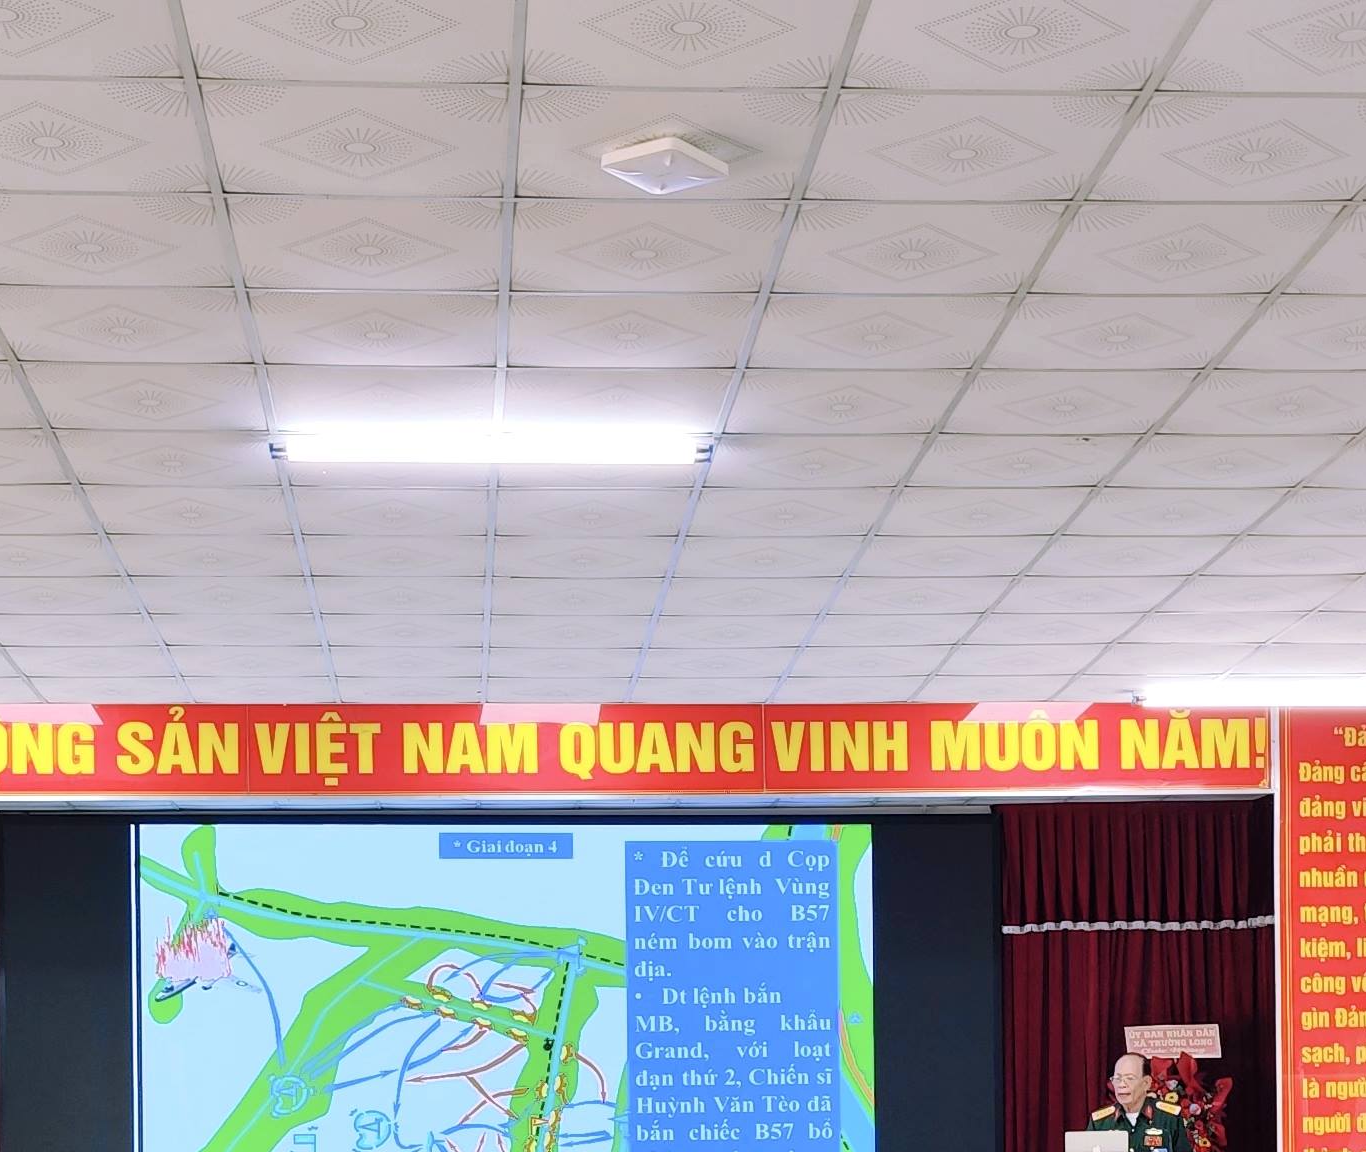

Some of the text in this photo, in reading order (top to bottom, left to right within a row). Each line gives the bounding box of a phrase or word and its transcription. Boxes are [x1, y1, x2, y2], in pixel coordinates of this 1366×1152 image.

[116, 707, 239, 775] SẢN
[254, 711, 381, 786] VIỆT
[404, 720, 537, 774] NAM
[559, 720, 754, 780] QUANG
[771, 720, 909, 771] VINH
[930, 709, 1099, 772] MUÔN
[1299, 760, 1345, 784] Đảng
[1300, 795, 1346, 819] đảng
[467, 840, 502, 853] Giai
[548, 841, 558, 853] 4
[1299, 829, 1342, 855] phải
[705, 850, 742, 868] cứu
[787, 851, 830, 872] Cọp
[682, 879, 713, 896] Tư
[719, 878, 762, 899] lệnh
[775, 878, 830, 899] Vùng
[634, 905, 830, 923] IV/CT cho B57
[634, 932, 830, 952] ném bom vào trận
[693, 987, 736, 1008] lệnh
[744, 983, 782, 1004] bắn
[636, 1009, 831, 1035] MB, bằng khẩu
[636, 1041, 831, 1061] Grand, với loạt
[682, 1069, 718, 1086] thứ
[724, 1069, 742, 1088] 2,
[748, 1064, 809, 1086] Chiến
[816, 1069, 833, 1085] sĩ
[637, 1096, 705, 1117] Huỳnh
[714, 1096, 754, 1113] Văn
[762, 1096, 800, 1113] Tèo
[637, 1120, 674, 1141] bắn
[689, 1118, 740, 1141] chiếc
[755, 1123, 794, 1140] B57
